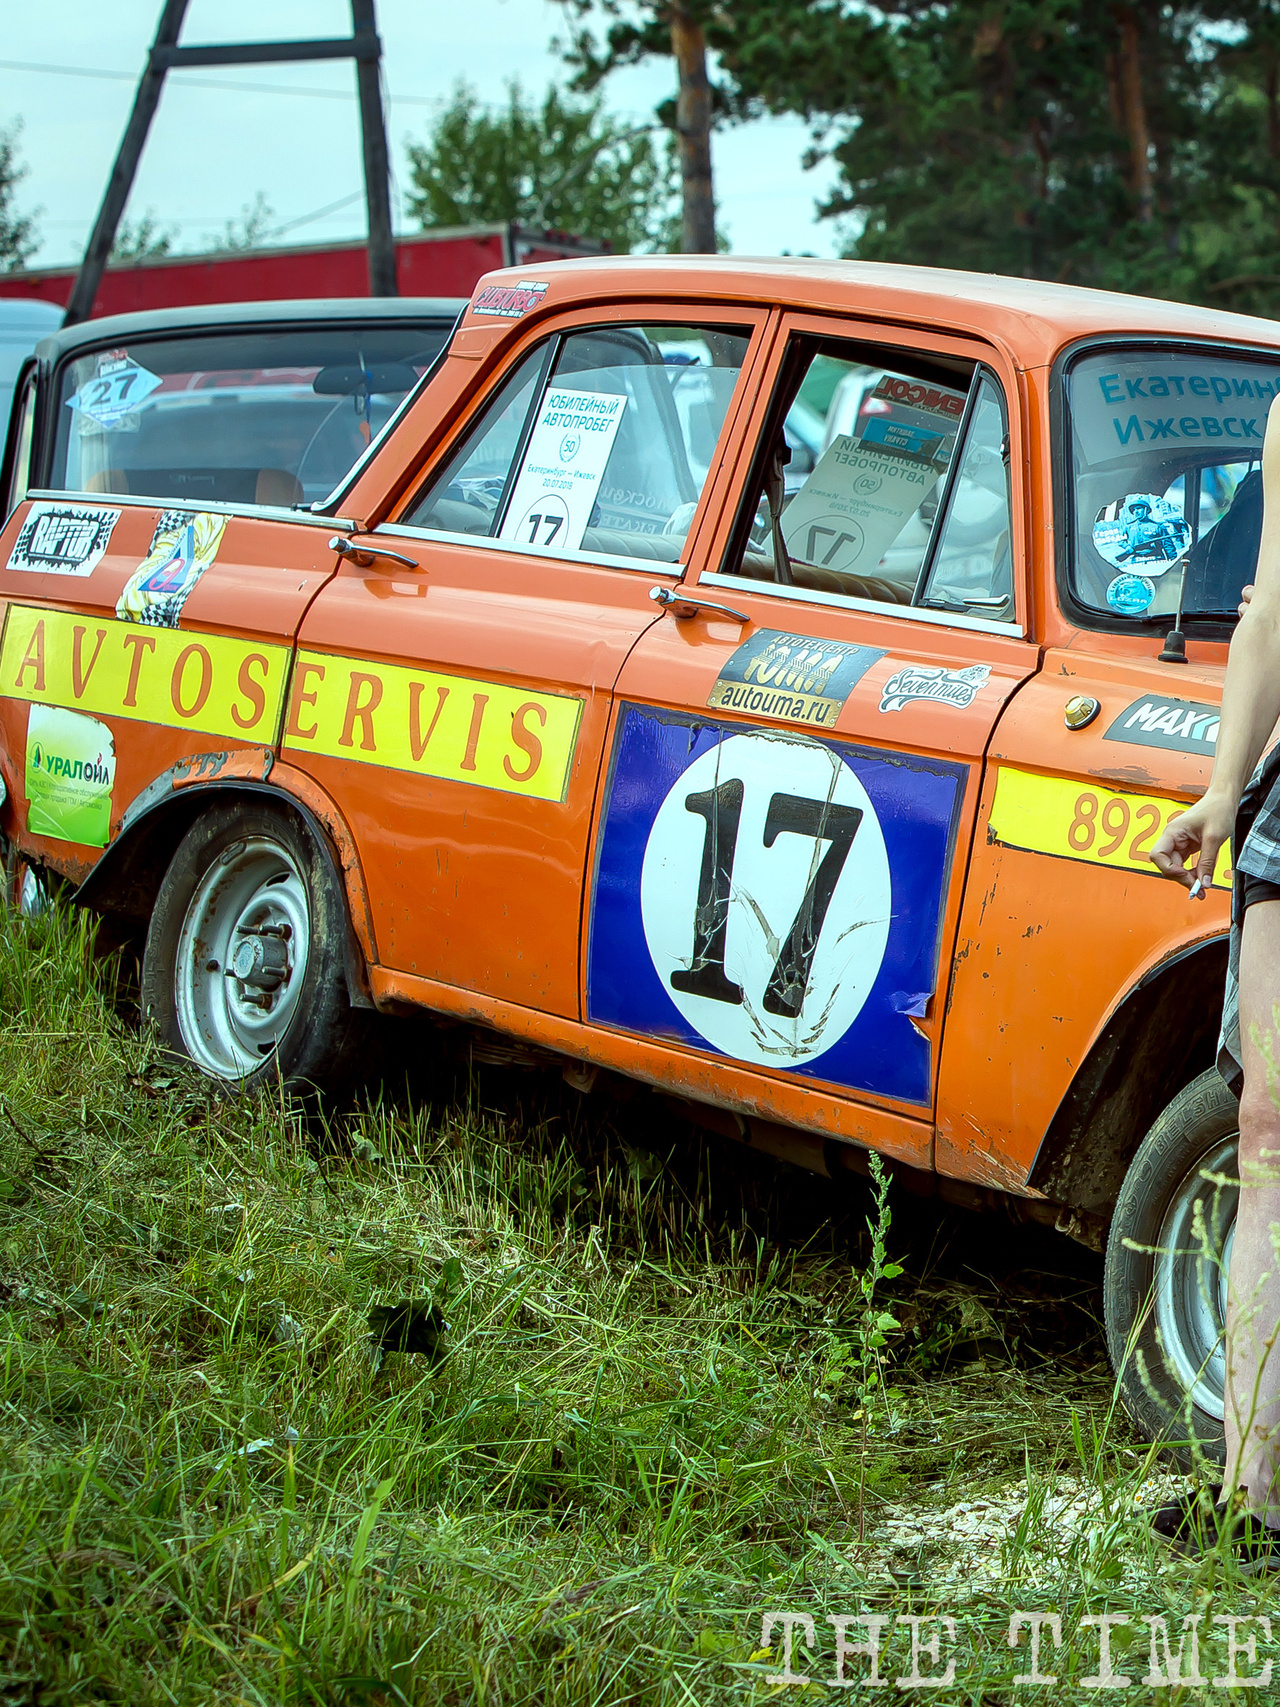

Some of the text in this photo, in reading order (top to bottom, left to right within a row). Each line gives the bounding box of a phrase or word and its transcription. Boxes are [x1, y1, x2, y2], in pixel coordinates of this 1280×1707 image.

[89, 373, 138, 407] 27
[548, 394, 620, 416] ЮБИЛЕЙНЫЙ
[542, 412, 614, 432] АВТОПРОБЕГ
[1112, 414, 1263, 445] Ижевск
[563, 440, 576, 453] 50
[528, 463, 596, 481] Екатеринбург Ижевск
[29, 514, 100, 560] RAPTOR
[528, 513, 564, 546] 17
[771, 634, 860, 656] АВТОТЕХЦЕНТР
[721, 686, 831, 723] autouma.ru
[1067, 792, 1187, 864] 892
[670, 777, 864, 1019] 17
